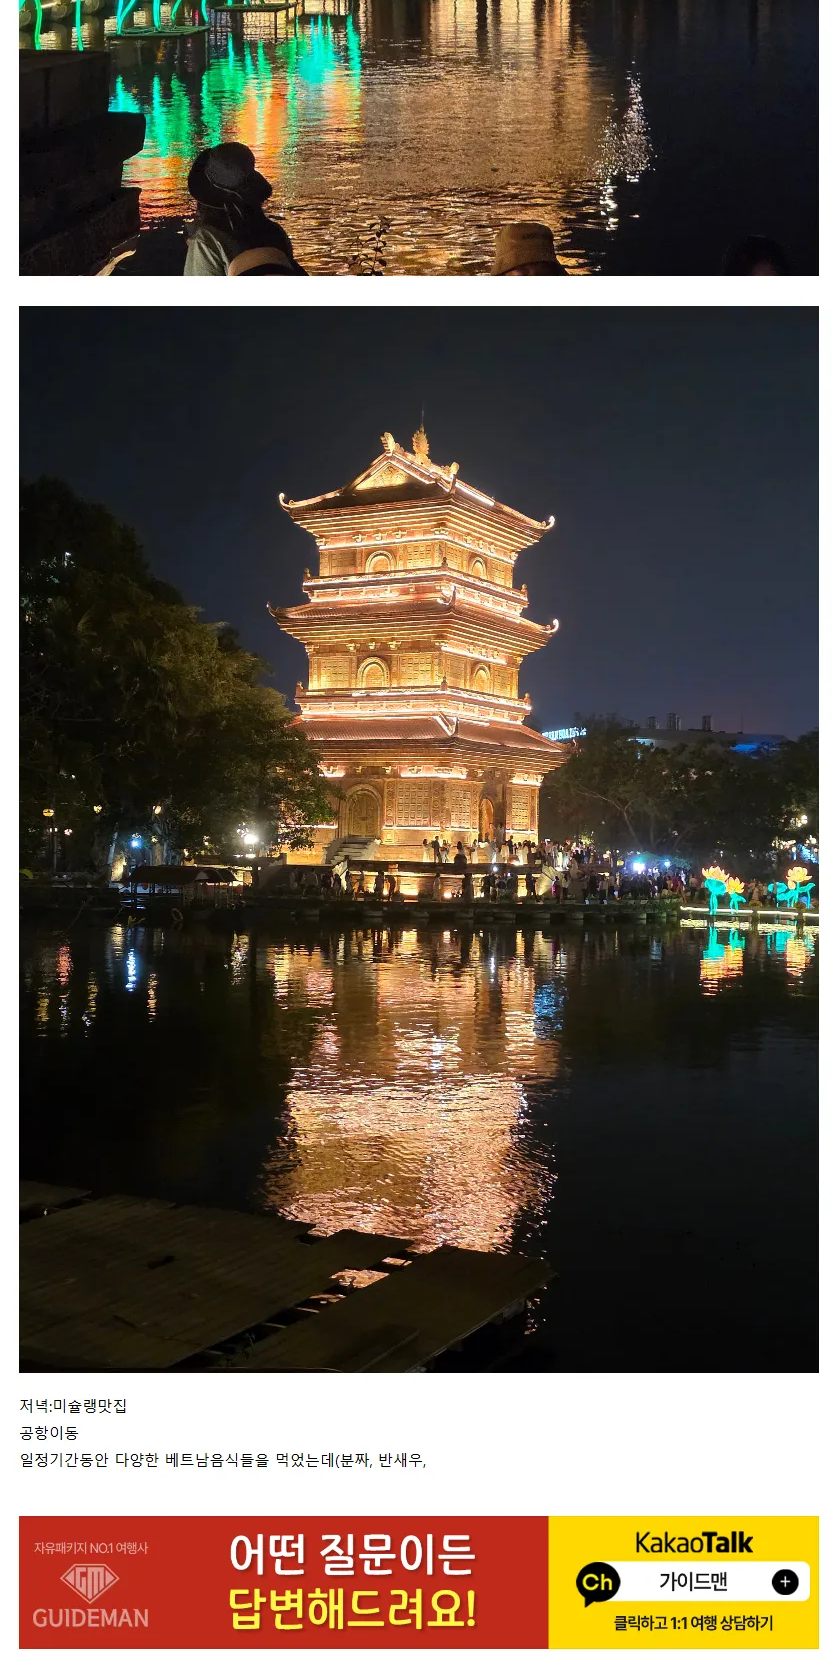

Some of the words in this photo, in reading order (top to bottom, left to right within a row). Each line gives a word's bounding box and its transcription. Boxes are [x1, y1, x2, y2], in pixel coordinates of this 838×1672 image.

[20, 1399, 125, 1413] 저녁:미슐랭맛집
[20, 1426, 78, 1440] 공항이동
[21, 1453, 108, 1467] 일정기간동안
[116, 1453, 159, 1467] 다양한
[166, 1453, 269, 1467] 베트남음식들을
[277, 1453, 372, 1468] 먹었는데(분짜,
[380, 1453, 425, 1468] 반새우,
[34, 1541, 87, 1555] 자유패키지
[90, 1542, 113, 1554] NO.1
[116, 1541, 149, 1555] 여행사
[636, 1531, 753, 1553] KakaoTalk
[230, 1534, 305, 1575] 어떤
[319, 1534, 476, 1575] 질문이든
[582, 1574, 613, 1591] Ch
[660, 1572, 728, 1592] 가이드맨
[229, 1588, 476, 1630] 답변해드려요!
[32, 1608, 149, 1628] GUIDEMAN
[614, 1615, 668, 1632] 클릭하고
[670, 1617, 688, 1630] 1:1
[691, 1615, 717, 1632] 여행
[720, 1615, 773, 1632] 상담하기
